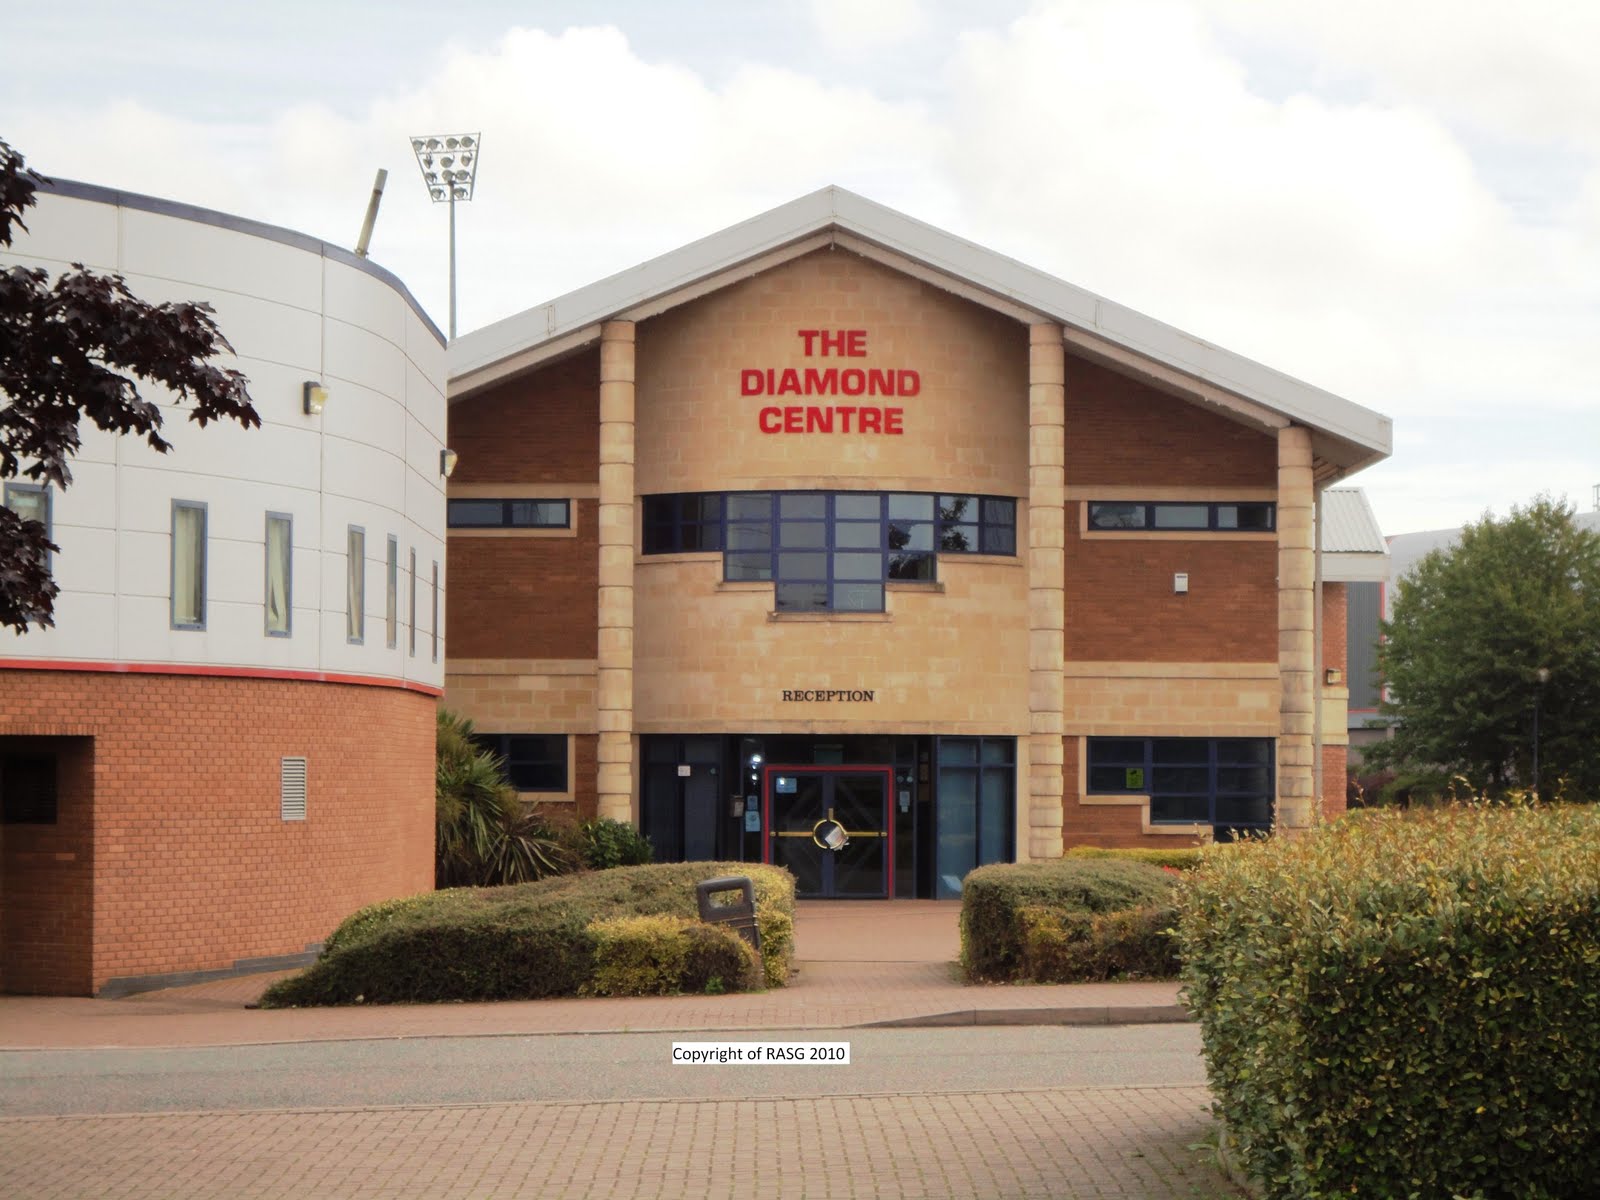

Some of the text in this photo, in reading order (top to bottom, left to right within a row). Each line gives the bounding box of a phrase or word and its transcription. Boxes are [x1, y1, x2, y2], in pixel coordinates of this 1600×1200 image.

[798, 330, 867, 357] THE
[741, 368, 921, 397] DIAMOND
[759, 406, 904, 435] CENTRE
[782, 690, 875, 702] RECEPTION
